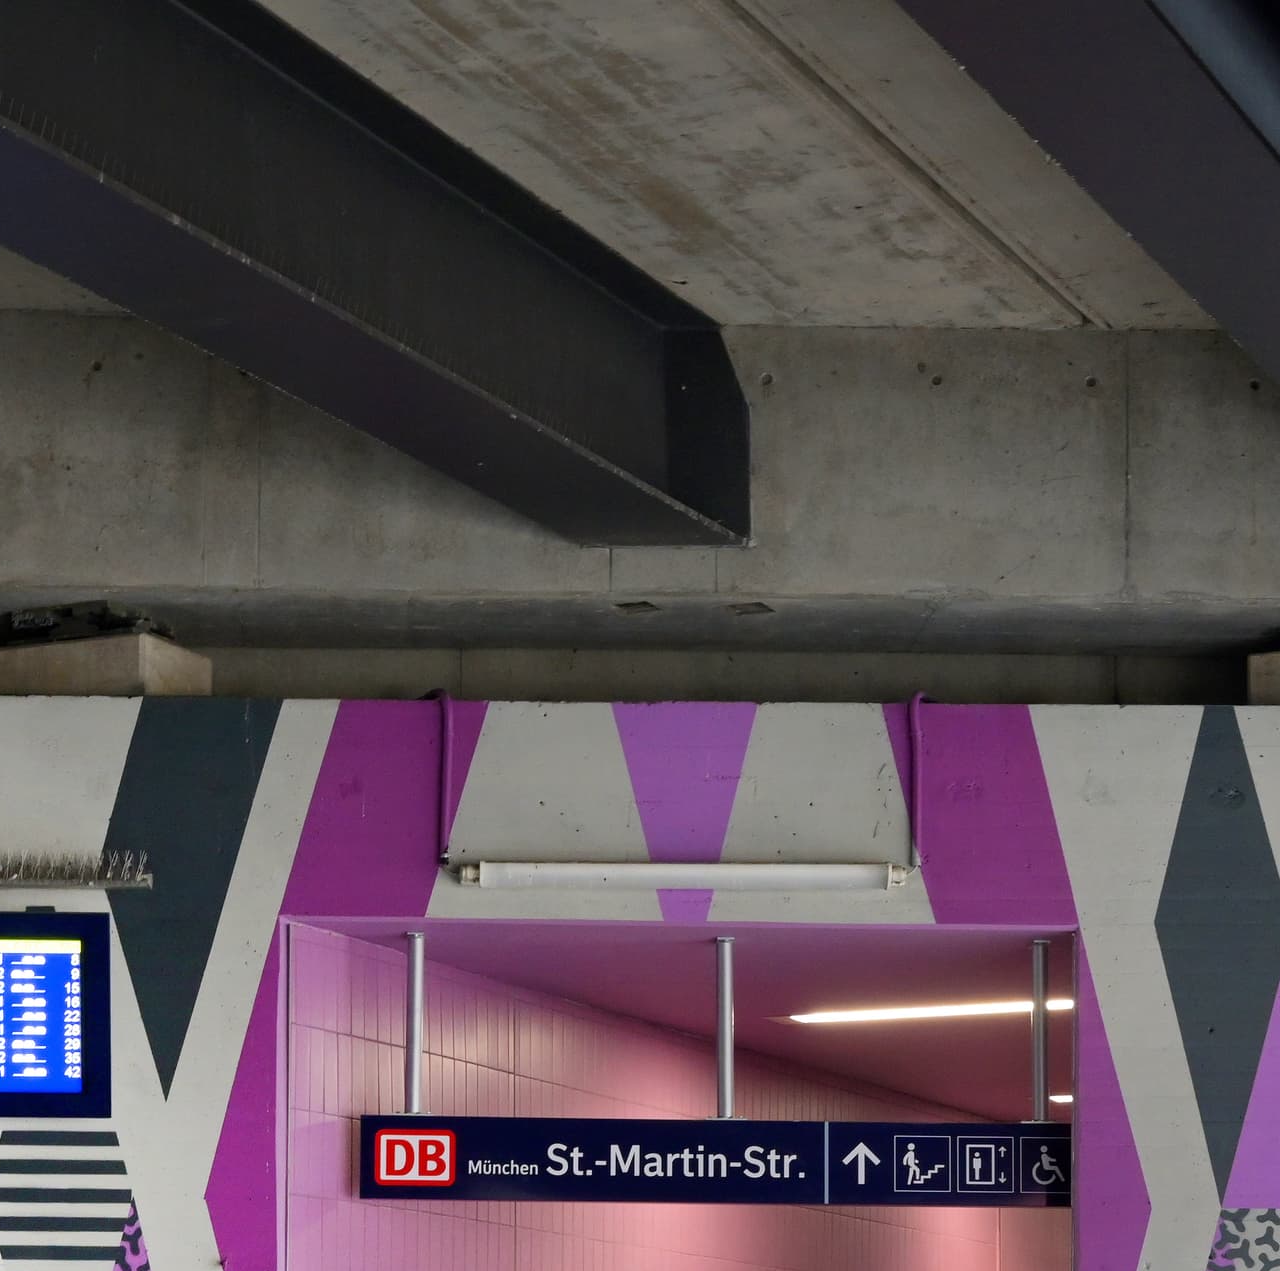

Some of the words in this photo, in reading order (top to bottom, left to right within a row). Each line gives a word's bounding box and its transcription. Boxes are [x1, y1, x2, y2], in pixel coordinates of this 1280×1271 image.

[70, 968, 80, 980] 9
[64, 1010, 81, 1022] 22
[64, 1024, 81, 1036] 28
[64, 1066, 81, 1078] 42
[384, 1139, 448, 1178] DB
[468, 1159, 539, 1176] München
[546, 1143, 806, 1179] St.-Martin-Str.
